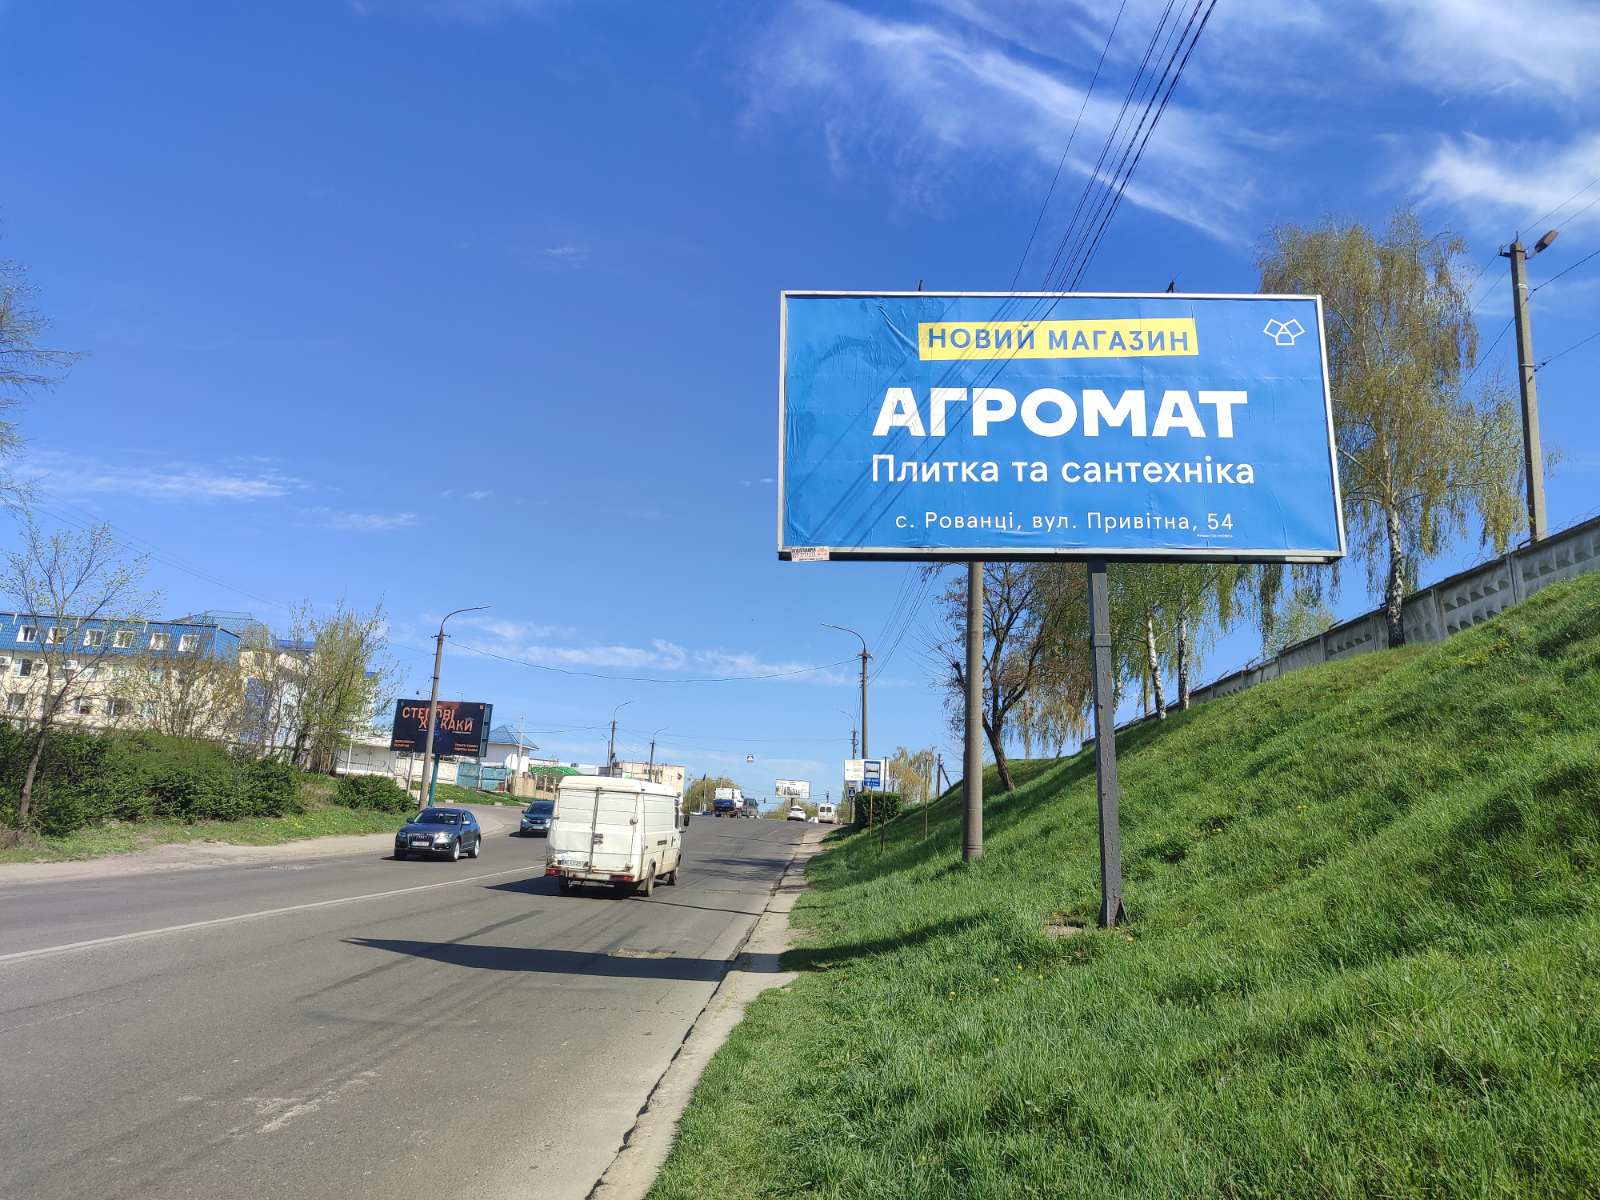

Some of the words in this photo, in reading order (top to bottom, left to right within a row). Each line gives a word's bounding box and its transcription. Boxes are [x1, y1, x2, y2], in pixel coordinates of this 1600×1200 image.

[928, 323, 1035, 349] НОВИЙ
[1048, 329, 1188, 351] МАГАЗИН
[871, 387, 1249, 439] АГРОМАТ
[871, 453, 1000, 483] Плитка
[1011, 460, 1049, 483] та
[1060, 455, 1255, 485] сантехніка
[894, 515, 915, 529] с.
[924, 511, 1023, 531] Рованці,
[1031, 514, 1077, 531] вул.
[1087, 512, 1198, 532] Привітна,
[1207, 513, 1235, 530] 54
